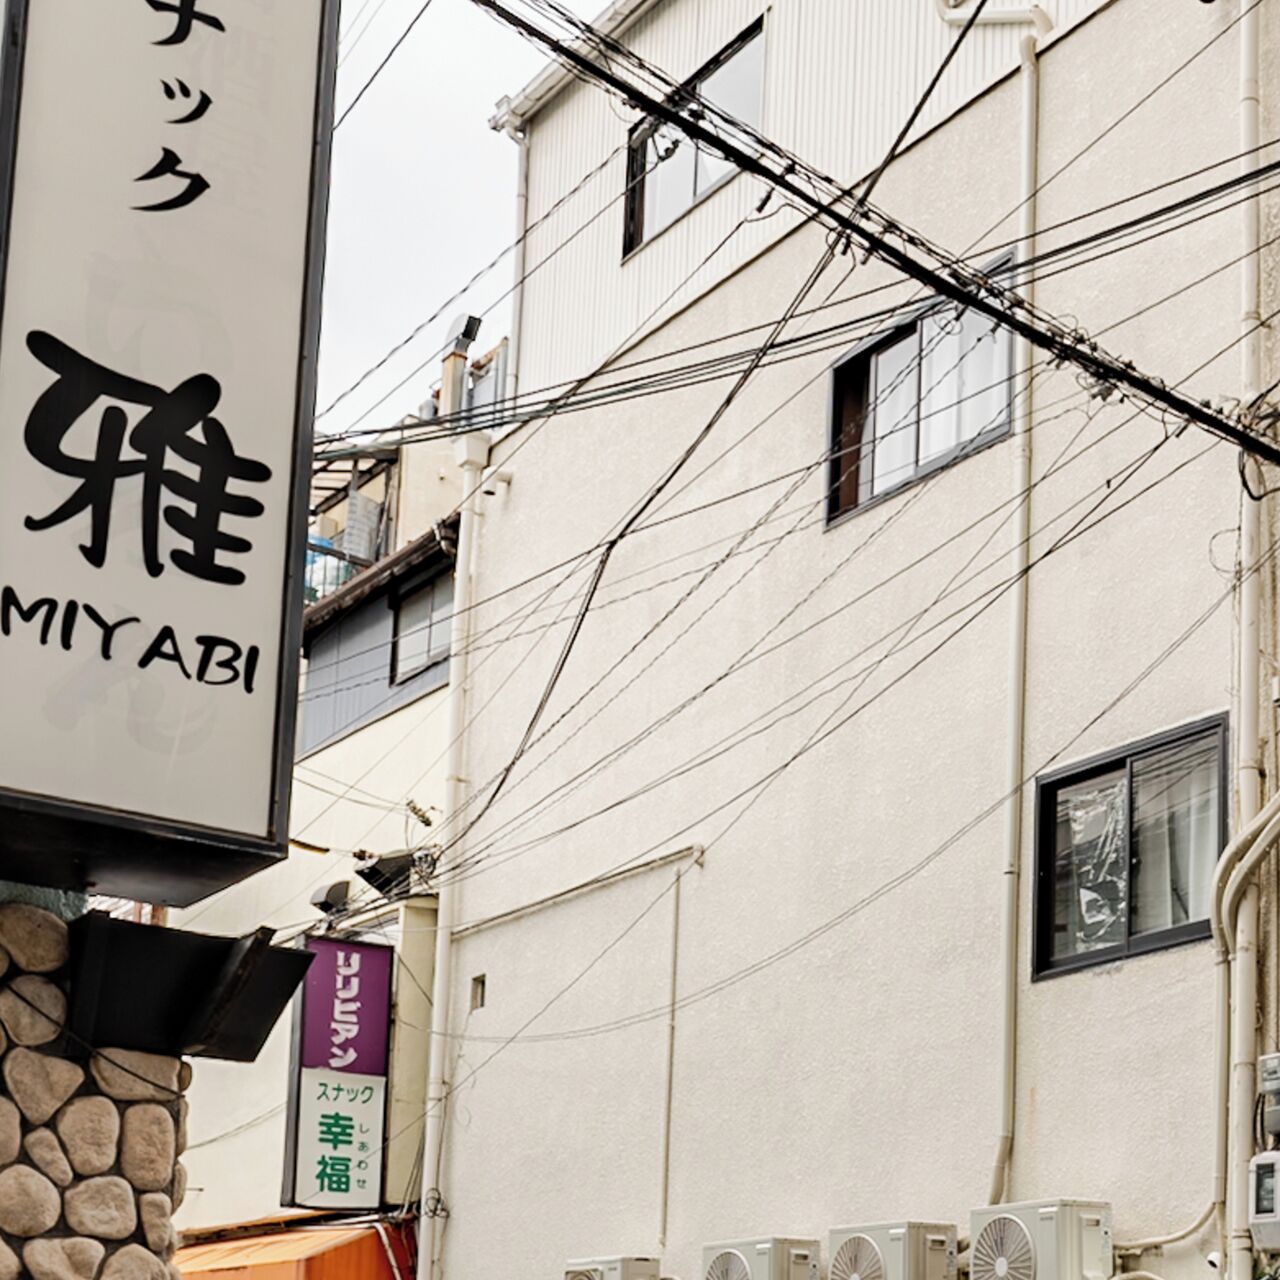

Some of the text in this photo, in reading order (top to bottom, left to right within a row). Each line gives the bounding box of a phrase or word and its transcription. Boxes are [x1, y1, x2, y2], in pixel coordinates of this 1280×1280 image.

[23, 328, 274, 587] 雅
[1, 586, 260, 695] MIYABI
[316, 1082, 374, 1105] スナック
[315, 1111, 355, 1194] 幸福
[356, 1122, 370, 1190] しあわせ
